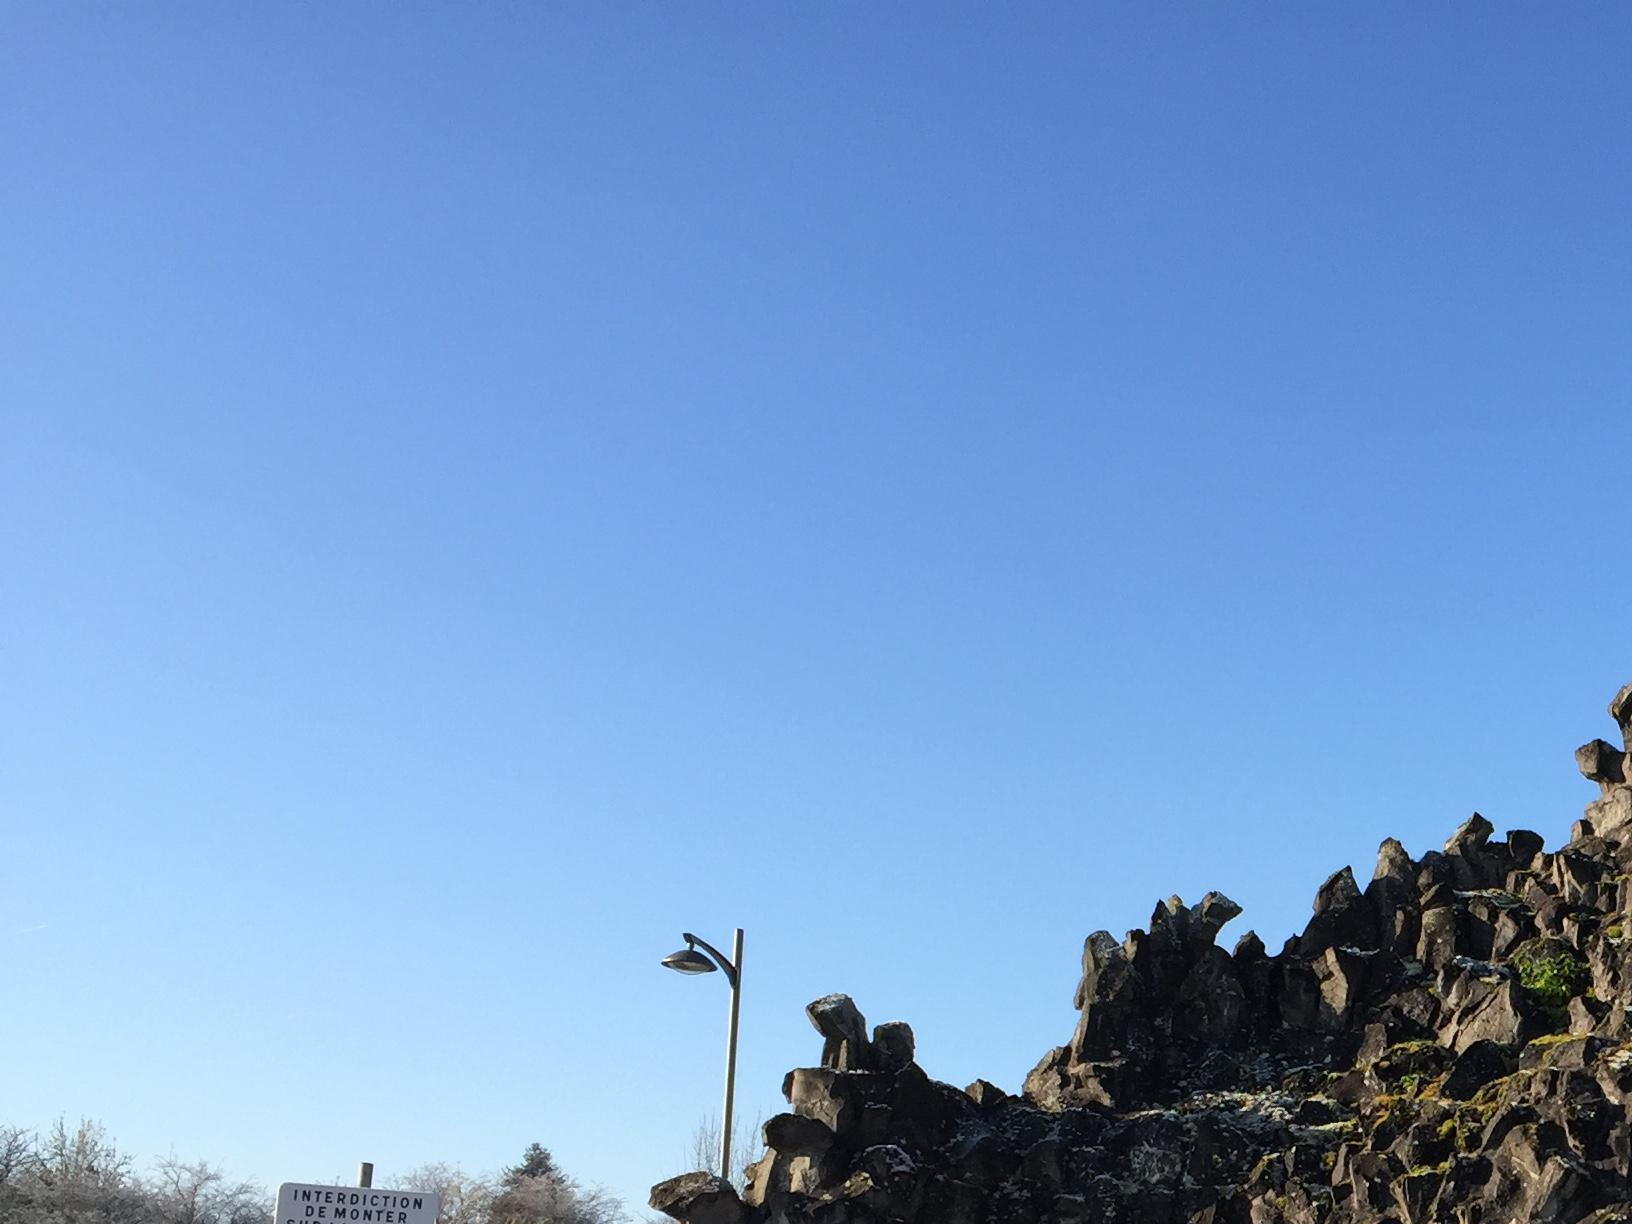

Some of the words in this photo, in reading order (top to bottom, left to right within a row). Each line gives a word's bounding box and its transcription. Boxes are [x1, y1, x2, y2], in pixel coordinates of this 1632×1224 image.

[293, 1189, 424, 1210] INTERDICTION
[305, 1205, 327, 1218] DE
[334, 1207, 408, 1224] MONTER
